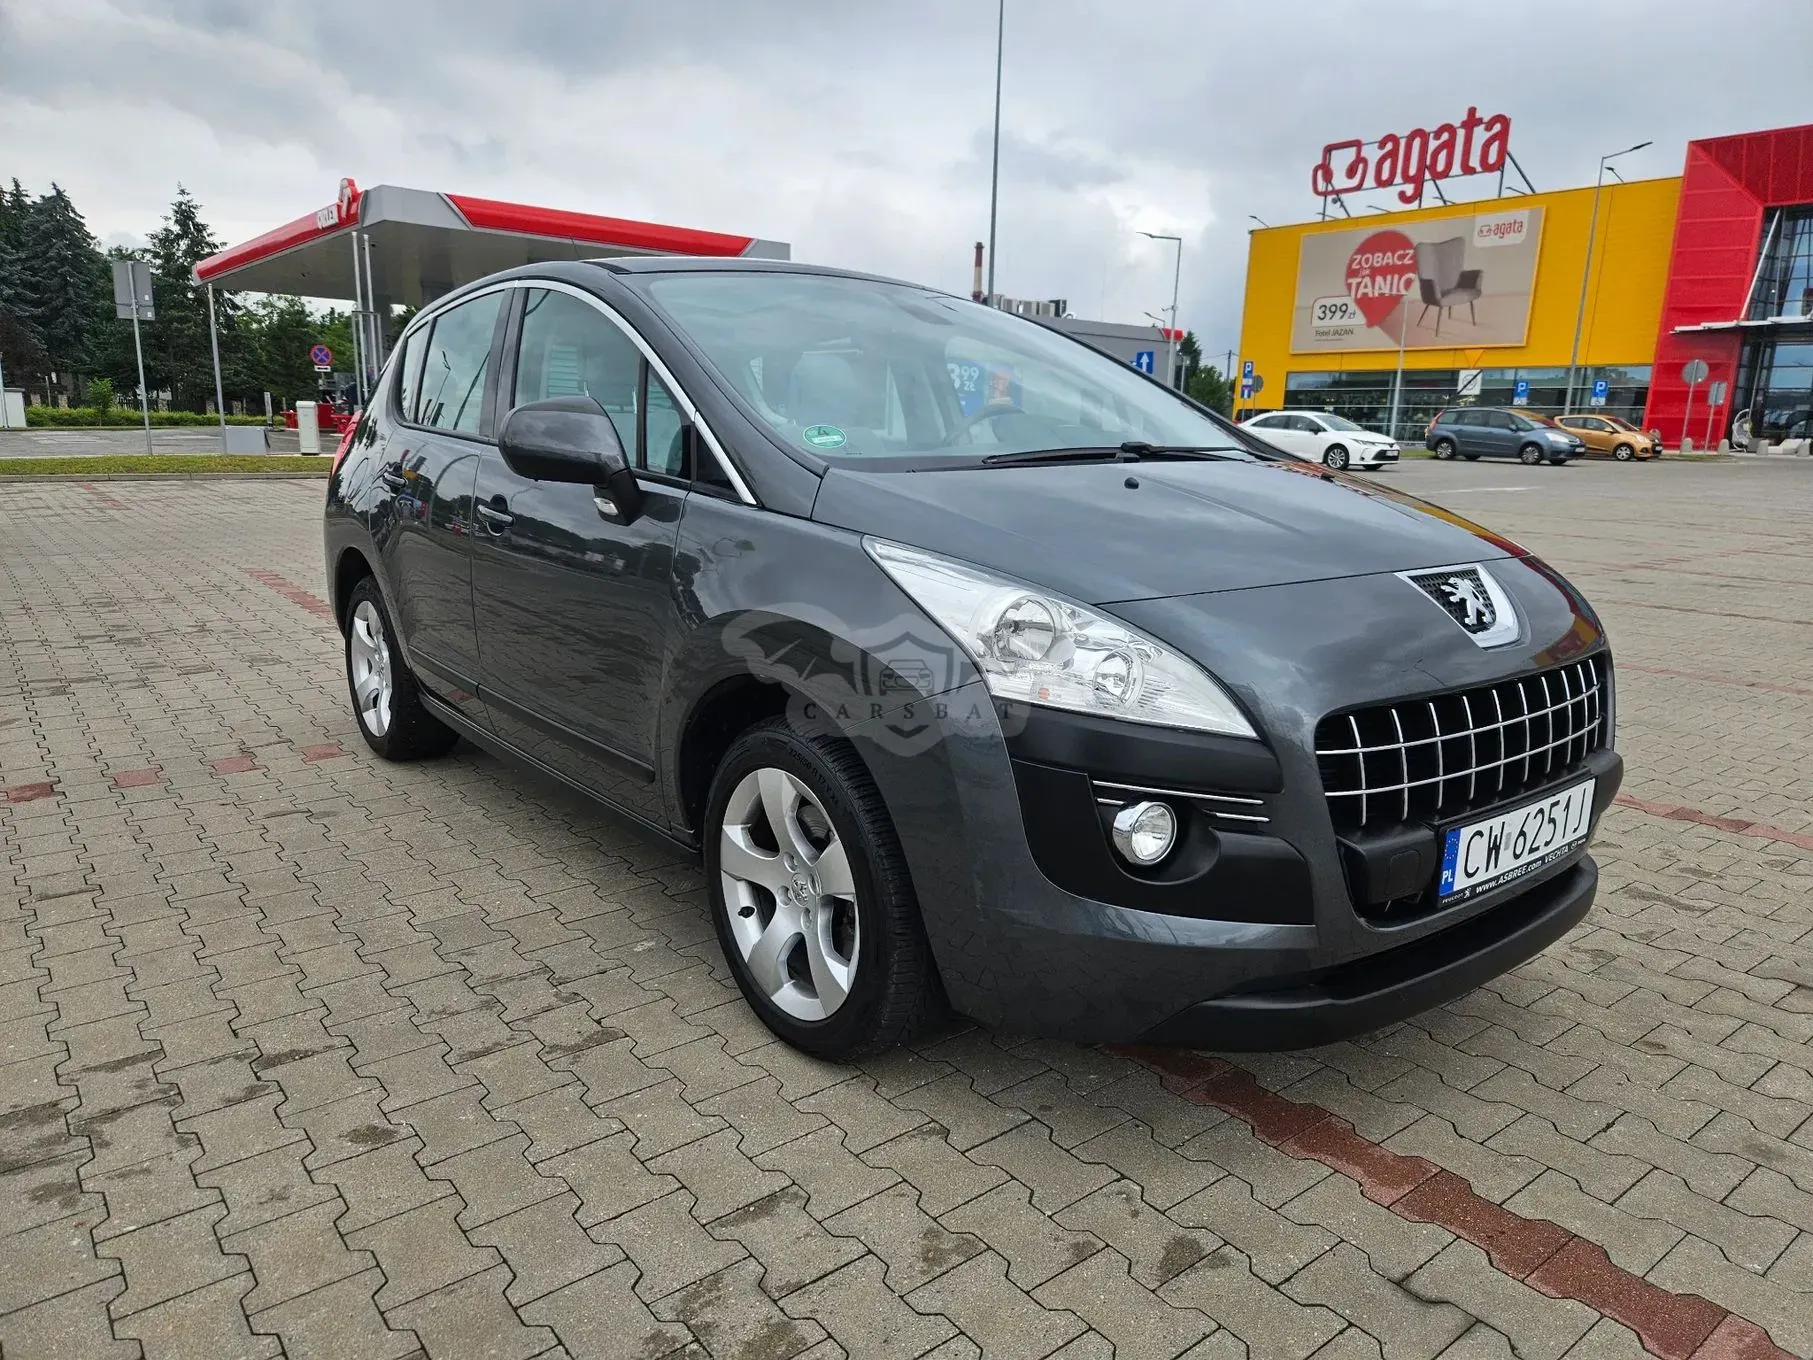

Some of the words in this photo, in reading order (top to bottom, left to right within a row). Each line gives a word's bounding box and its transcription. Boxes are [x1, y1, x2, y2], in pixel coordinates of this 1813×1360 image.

[1374, 106, 1509, 204] agata
[1493, 219, 1524, 239] agata
[1351, 249, 1415, 269] ZOBACZ
[1347, 272, 1416, 298] TANIO
[1318, 303, 1349, 321] 399
[1244, 362, 1252, 373] P
[1517, 382, 1527, 392] P
[1595, 382, 1606, 392] P
[1464, 821, 1506, 878] CW
[1512, 787, 1587, 861] 6251J
[1442, 869, 1453, 885] PL
